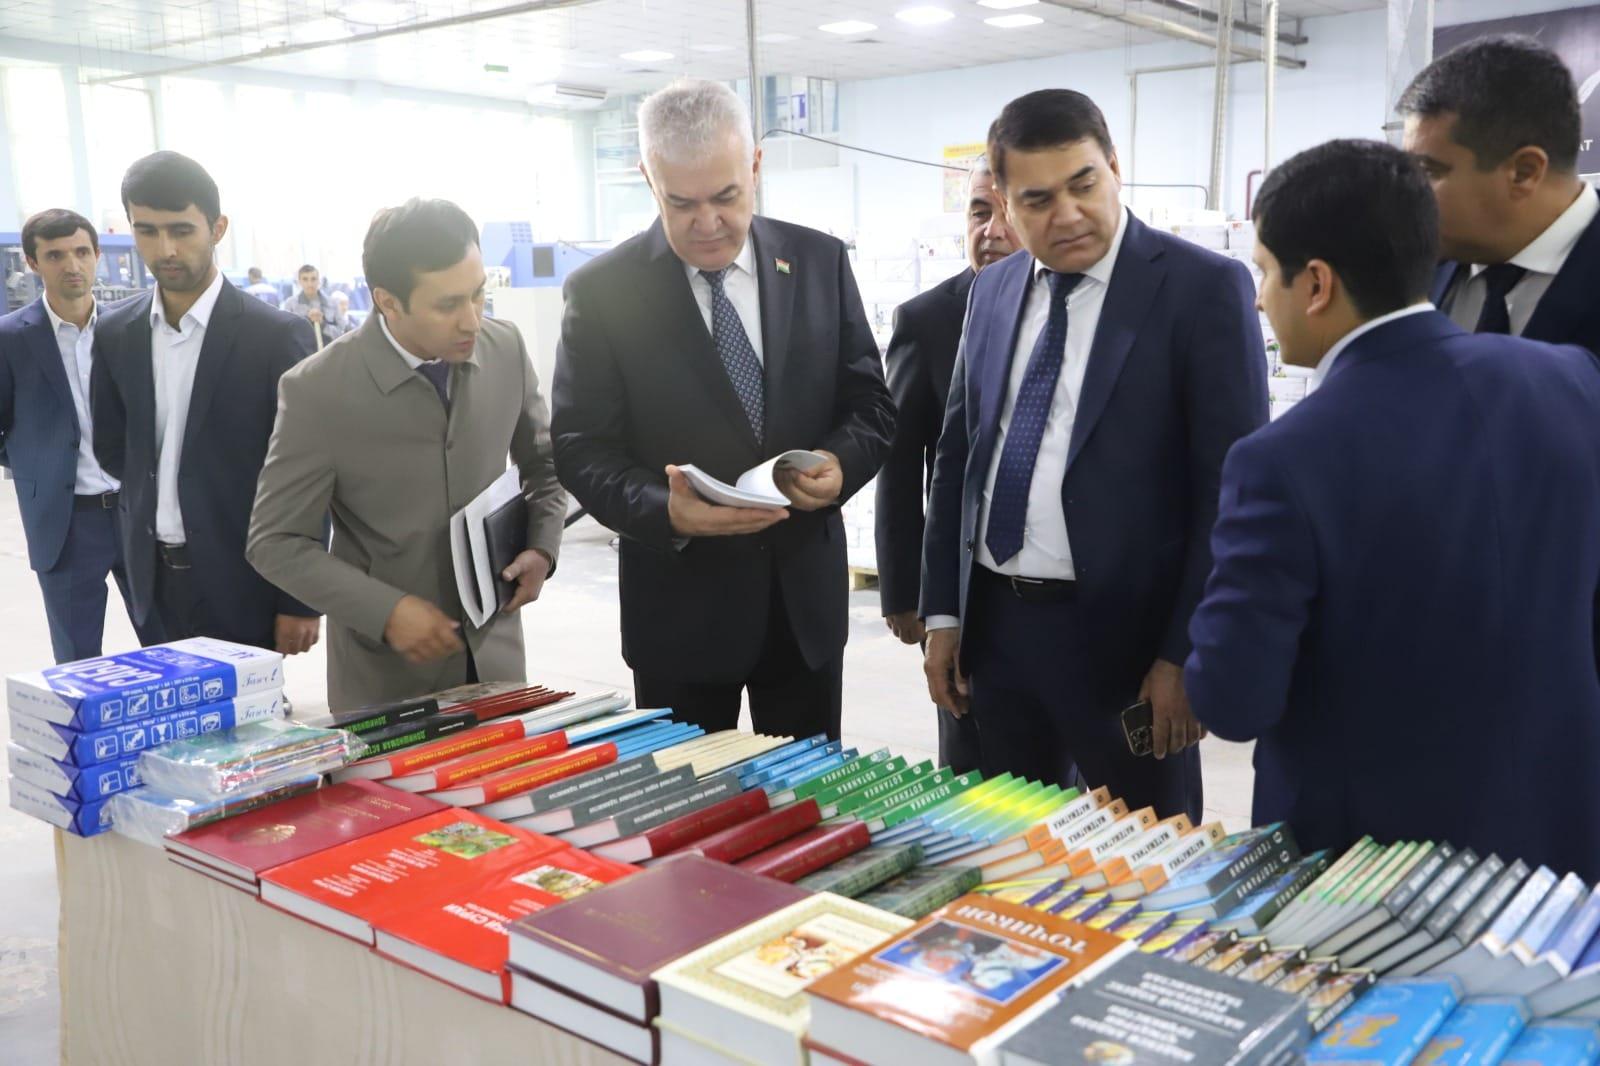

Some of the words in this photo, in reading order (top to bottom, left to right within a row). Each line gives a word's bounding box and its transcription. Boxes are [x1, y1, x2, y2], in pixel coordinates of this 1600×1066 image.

[821, 761, 860, 784] БОТАНИКА
[836, 770, 876, 795] БОТАНИКА
[864, 774, 903, 798] БОТАНИКА
[883, 783, 924, 808] БОТАНИКА
[910, 786, 950, 811] БОТАНИКА
[1053, 803, 1091, 830] МАТЕМАТИКА
[1068, 815, 1106, 844] МАТЕМАТИКА
[1096, 825, 1135, 854] МАТЕМАТИКА
[1131, 832, 1170, 862] МАТЕМАТИКА
[1168, 839, 1205, 870] МАТЕМАТИКА
[1228, 840, 1271, 878] ГЕОГРАФИЯ
[1236, 860, 1279, 899] ГЕОГРАФИЯ
